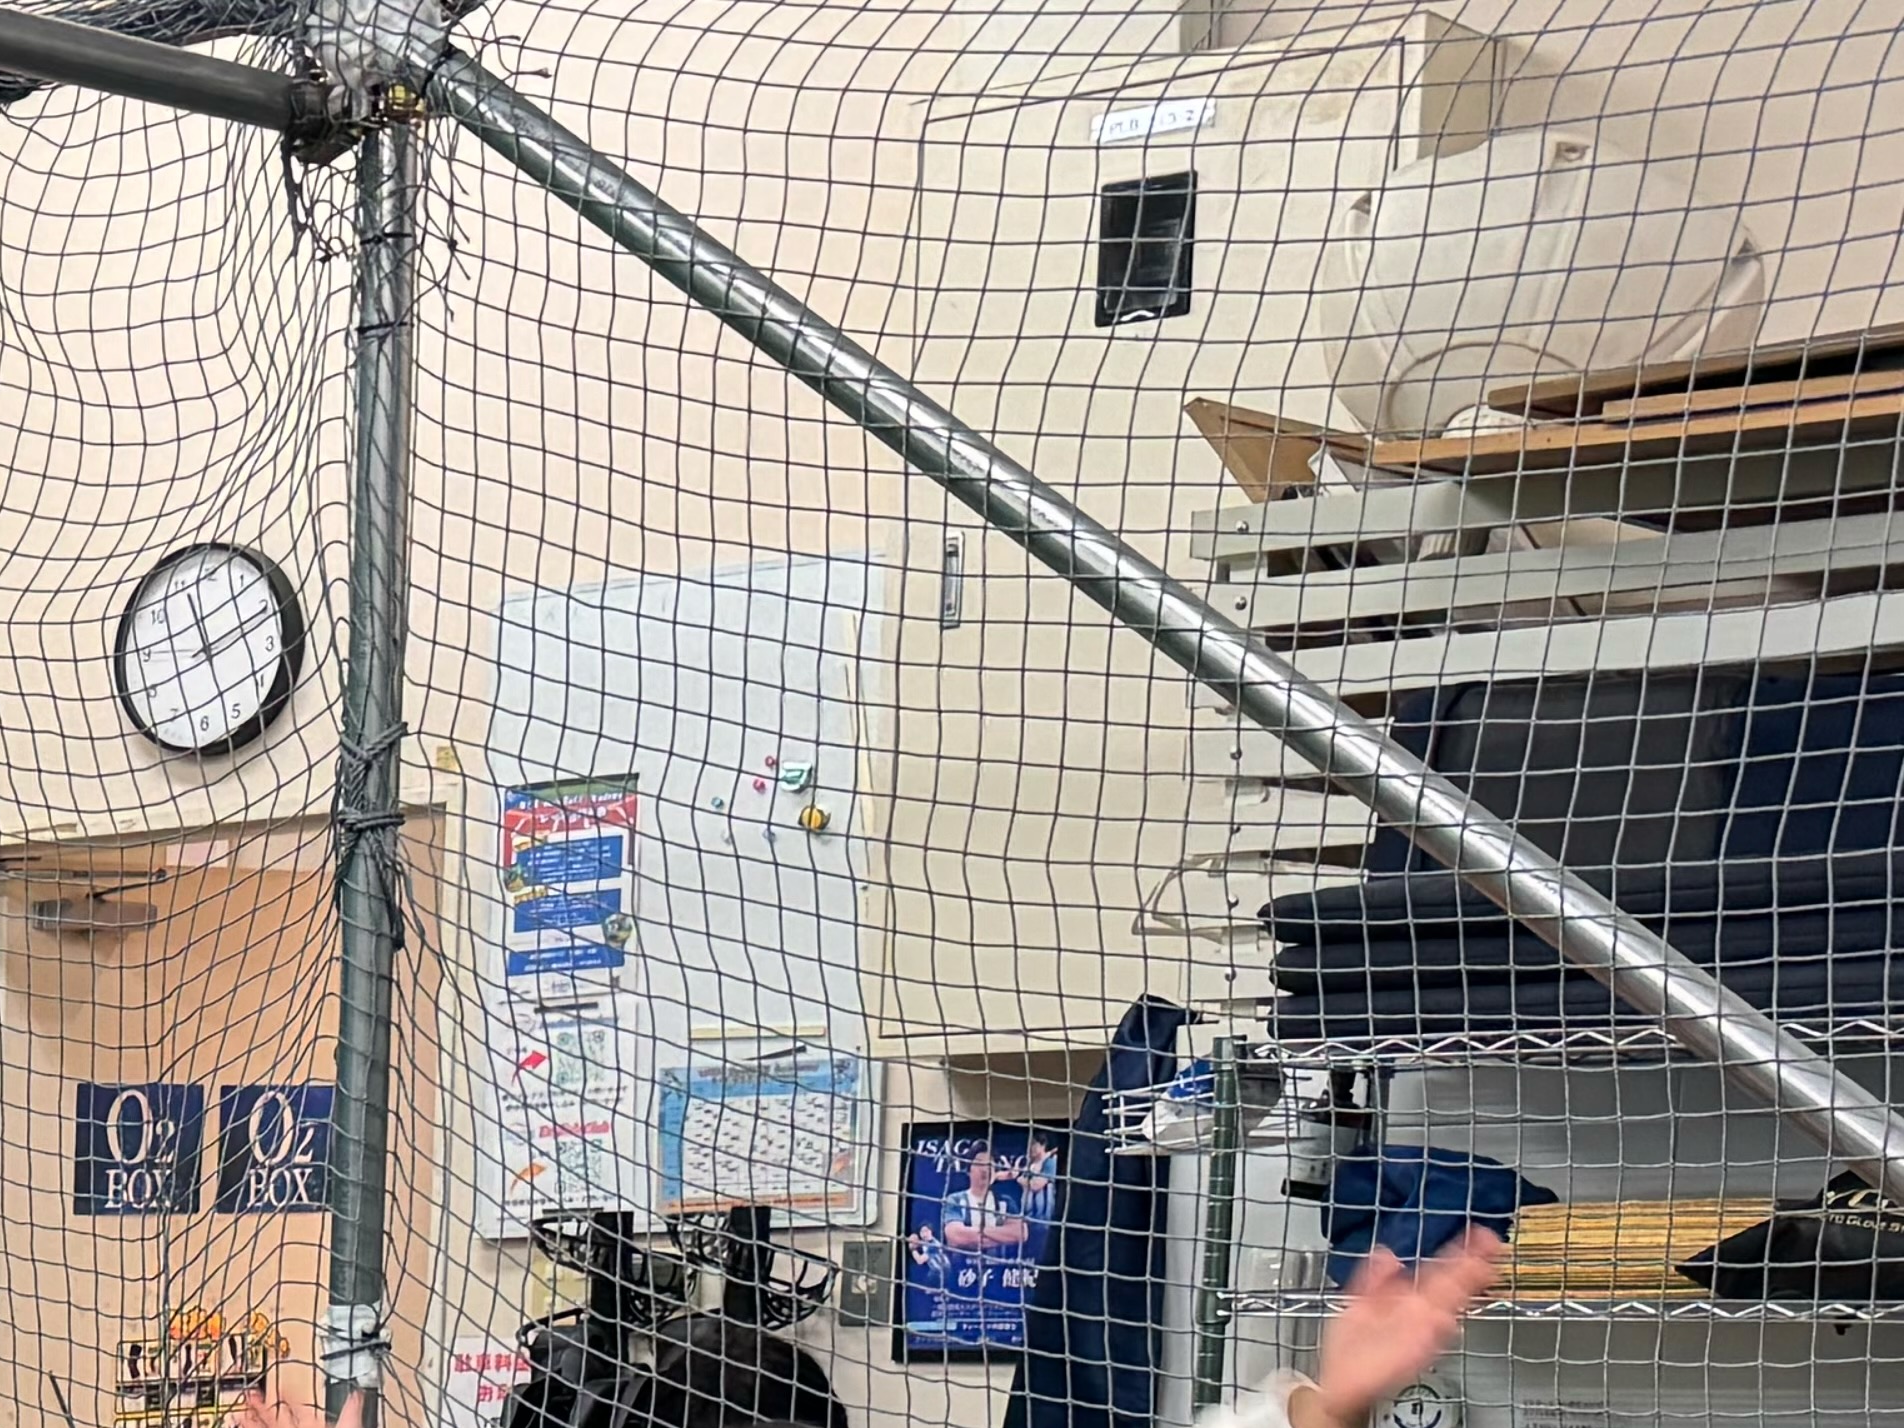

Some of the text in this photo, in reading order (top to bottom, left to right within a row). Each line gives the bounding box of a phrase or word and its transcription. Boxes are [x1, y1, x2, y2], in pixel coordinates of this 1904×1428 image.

[264, 635, 275, 652] 3
[230, 702, 241, 719] 5
[199, 715, 210, 732] 6
[104, 1169, 172, 1209] BOX
[247, 1168, 313, 1209] BOX
